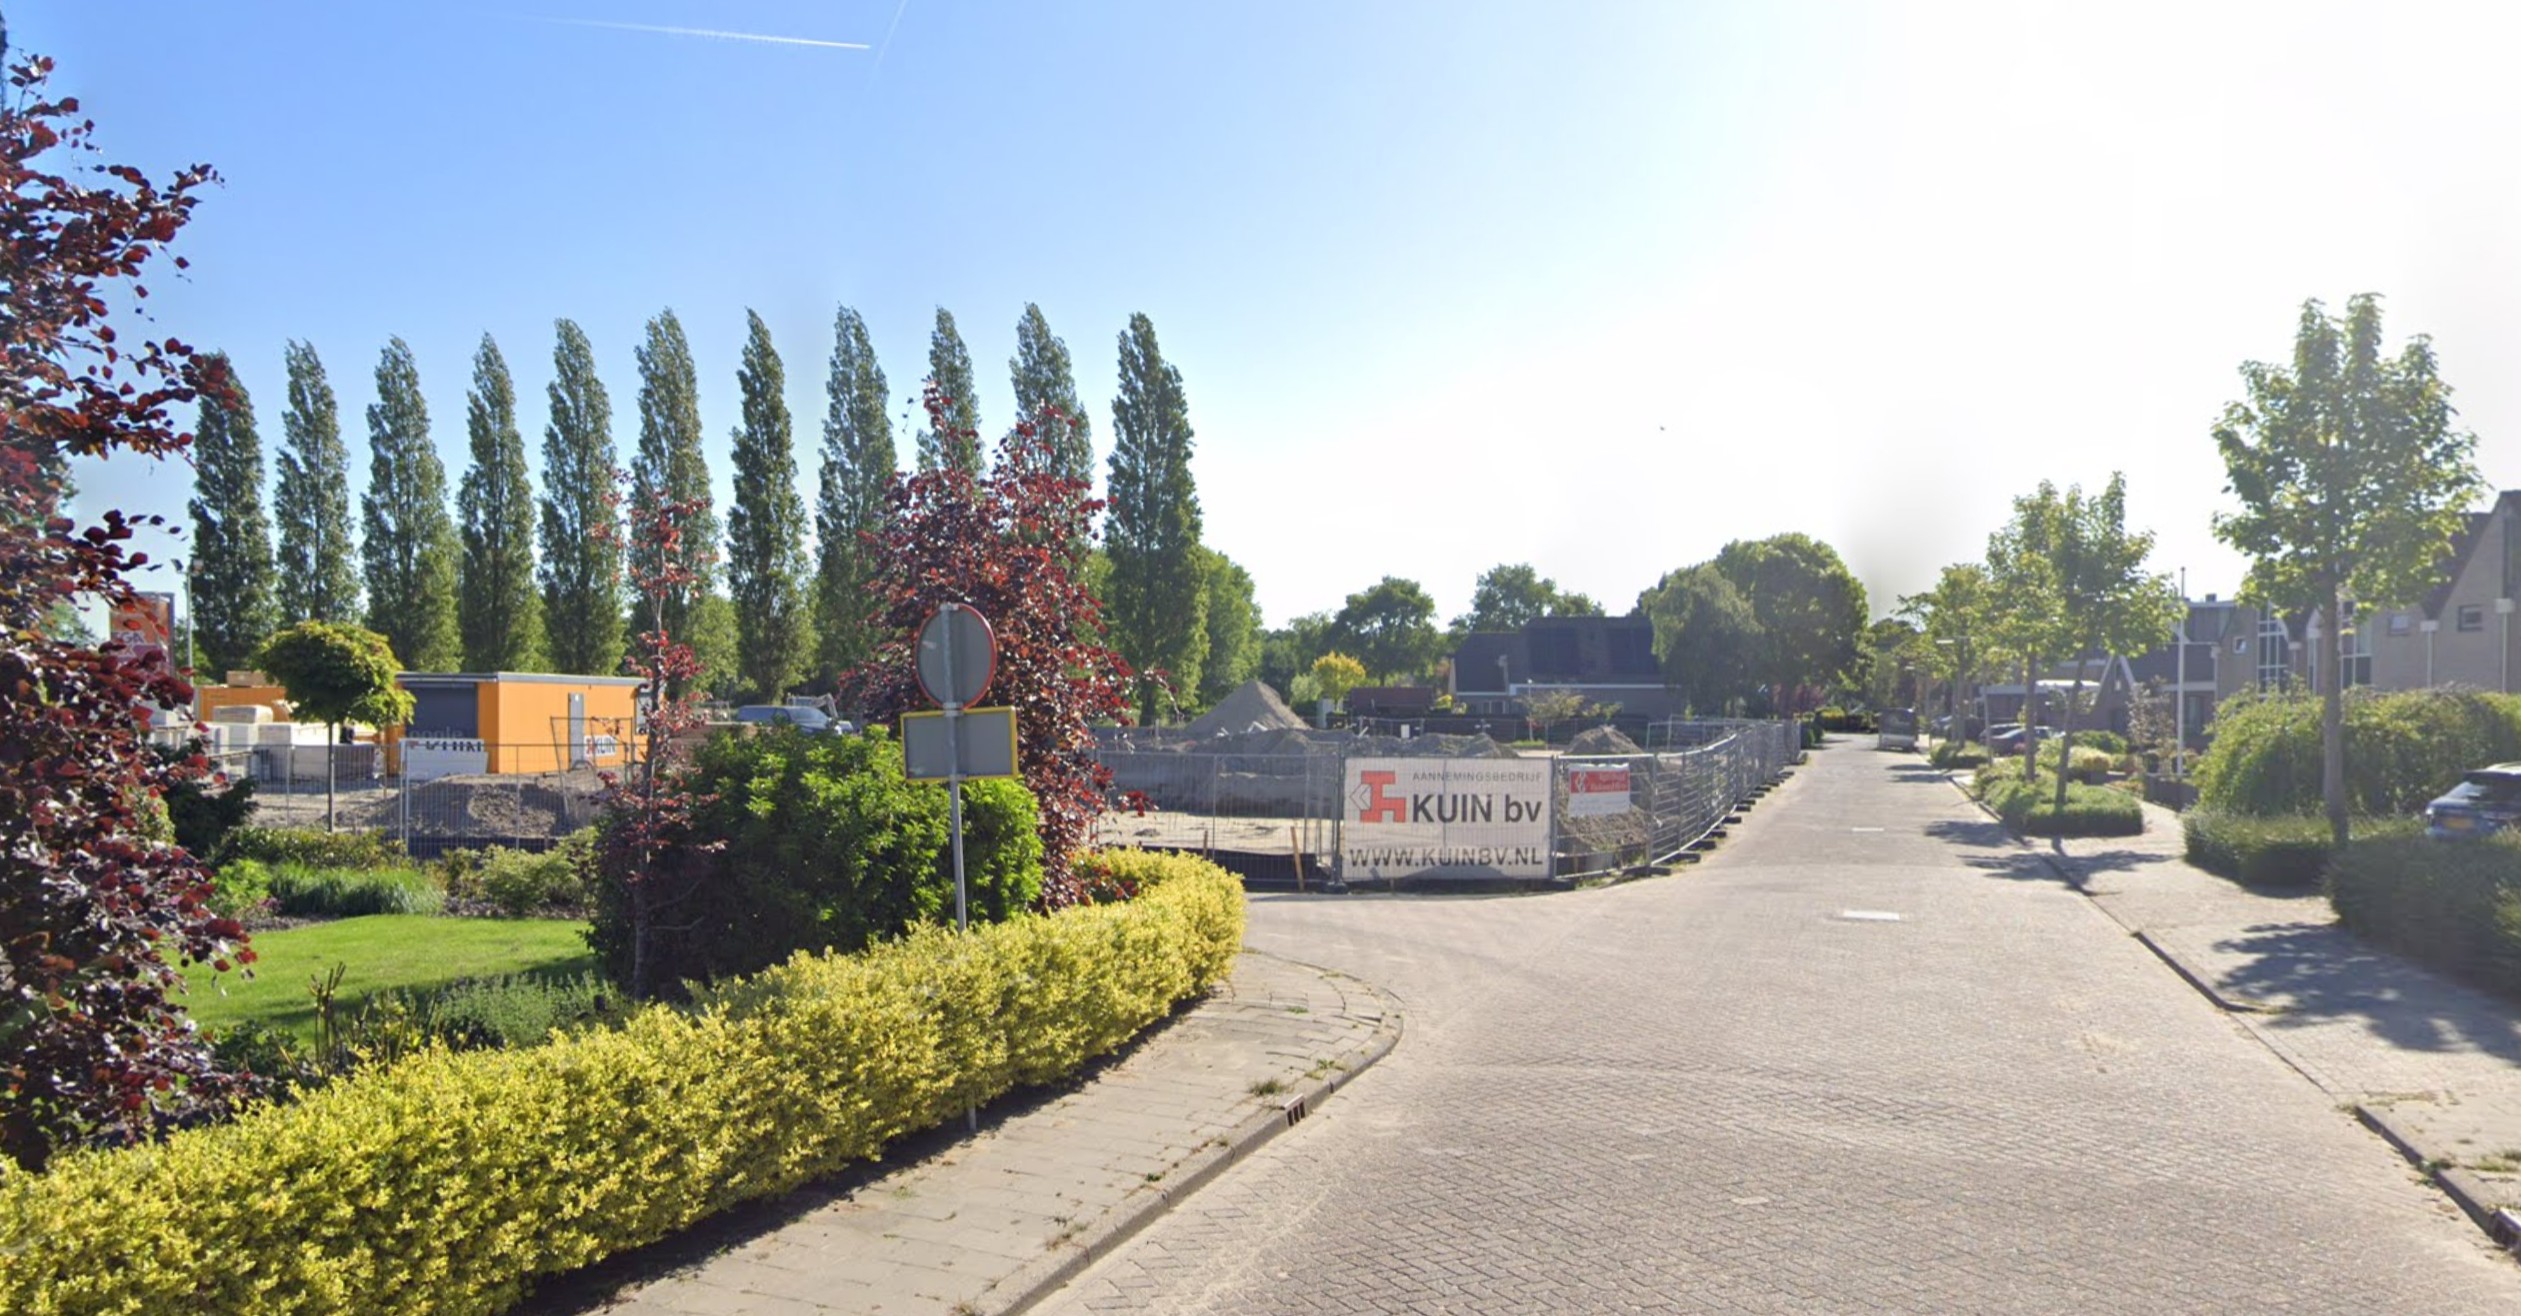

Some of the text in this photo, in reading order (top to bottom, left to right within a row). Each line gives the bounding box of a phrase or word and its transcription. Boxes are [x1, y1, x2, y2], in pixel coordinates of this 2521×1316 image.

[1412, 771, 1543, 783] AANNEMINGSBEDRIJF
[1412, 794, 1492, 824] KUIN
[1504, 793, 1542, 823] bv
[1350, 848, 1543, 867] WWW.KUINBV.NL
